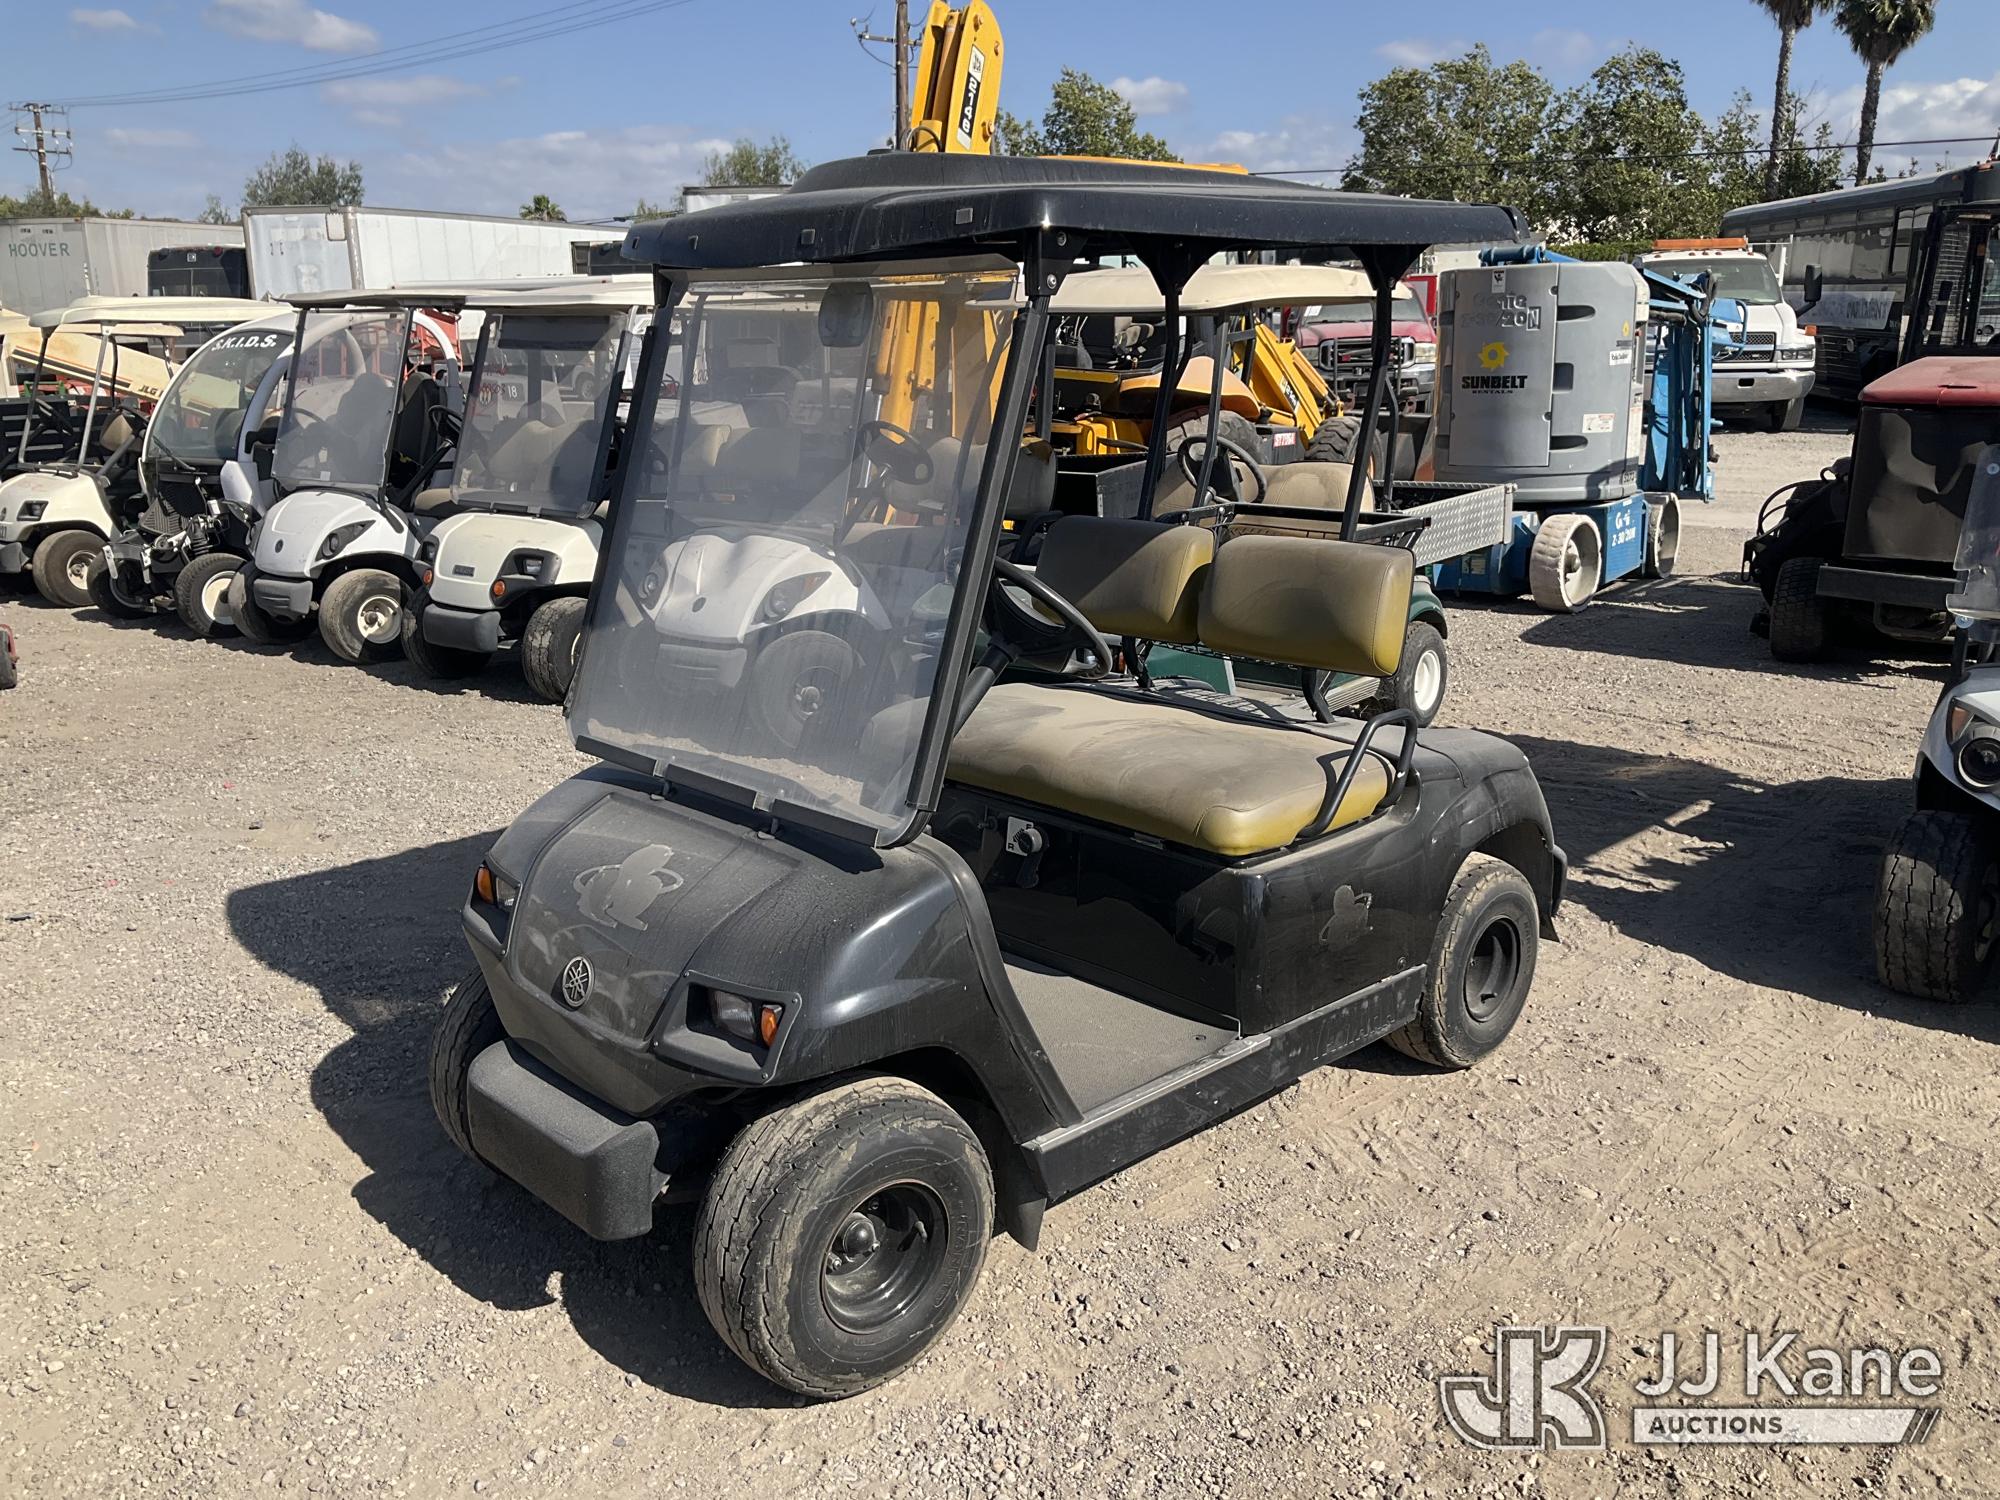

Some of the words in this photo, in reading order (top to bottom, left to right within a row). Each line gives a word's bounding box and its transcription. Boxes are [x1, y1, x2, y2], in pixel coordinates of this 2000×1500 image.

[8, 242, 71, 257] HOOVER
[1461, 375, 1528, 389] SUNBELT
[138, 385, 159, 396] JLG
[507, 385, 518, 398] 18
